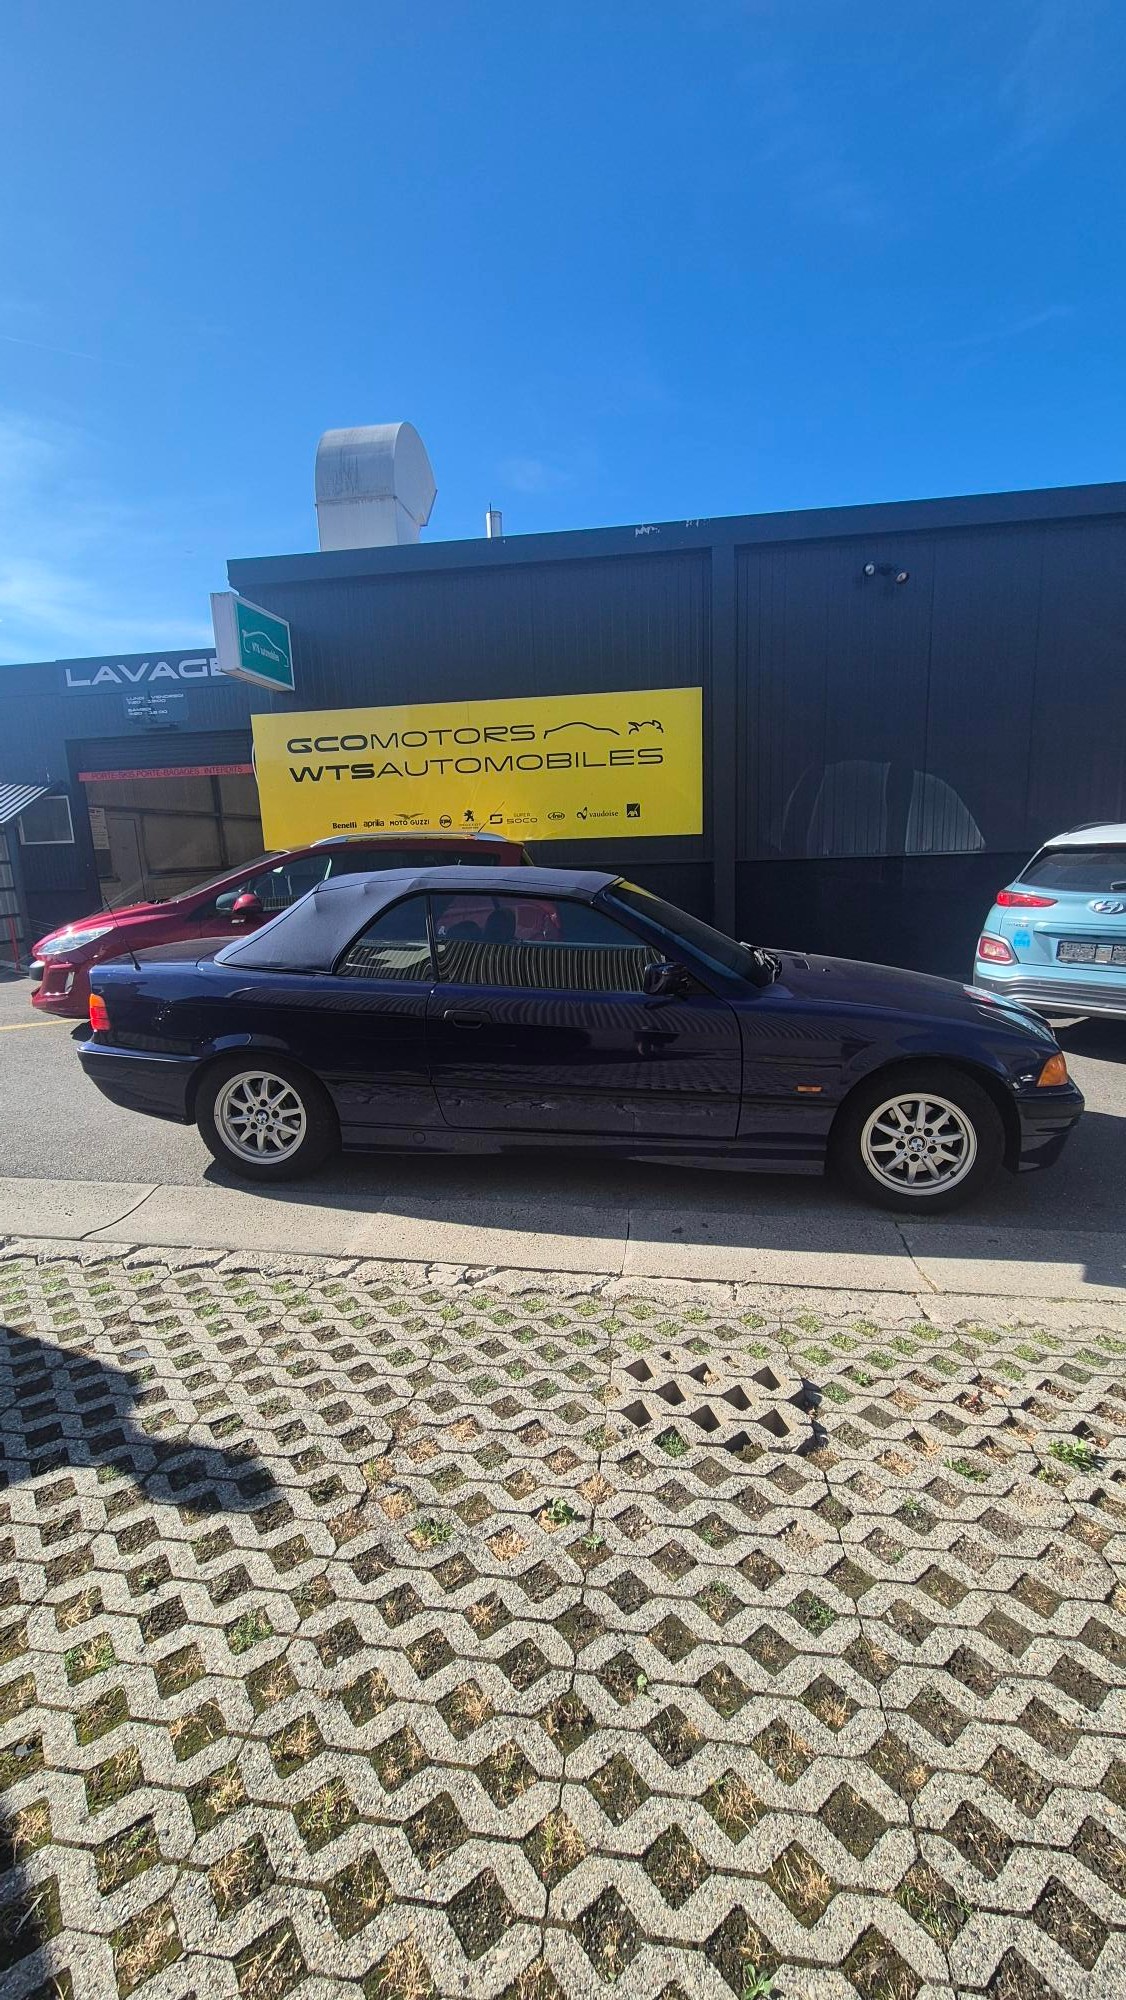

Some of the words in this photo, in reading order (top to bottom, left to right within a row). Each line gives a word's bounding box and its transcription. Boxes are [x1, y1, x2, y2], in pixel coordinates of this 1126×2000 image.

[286, 724, 535, 754] GCOMOTORS
[288, 747, 664, 783] WTSAUTOMOBILES
[332, 821, 357, 829] Benelli
[363, 819, 385, 828] aprilia
